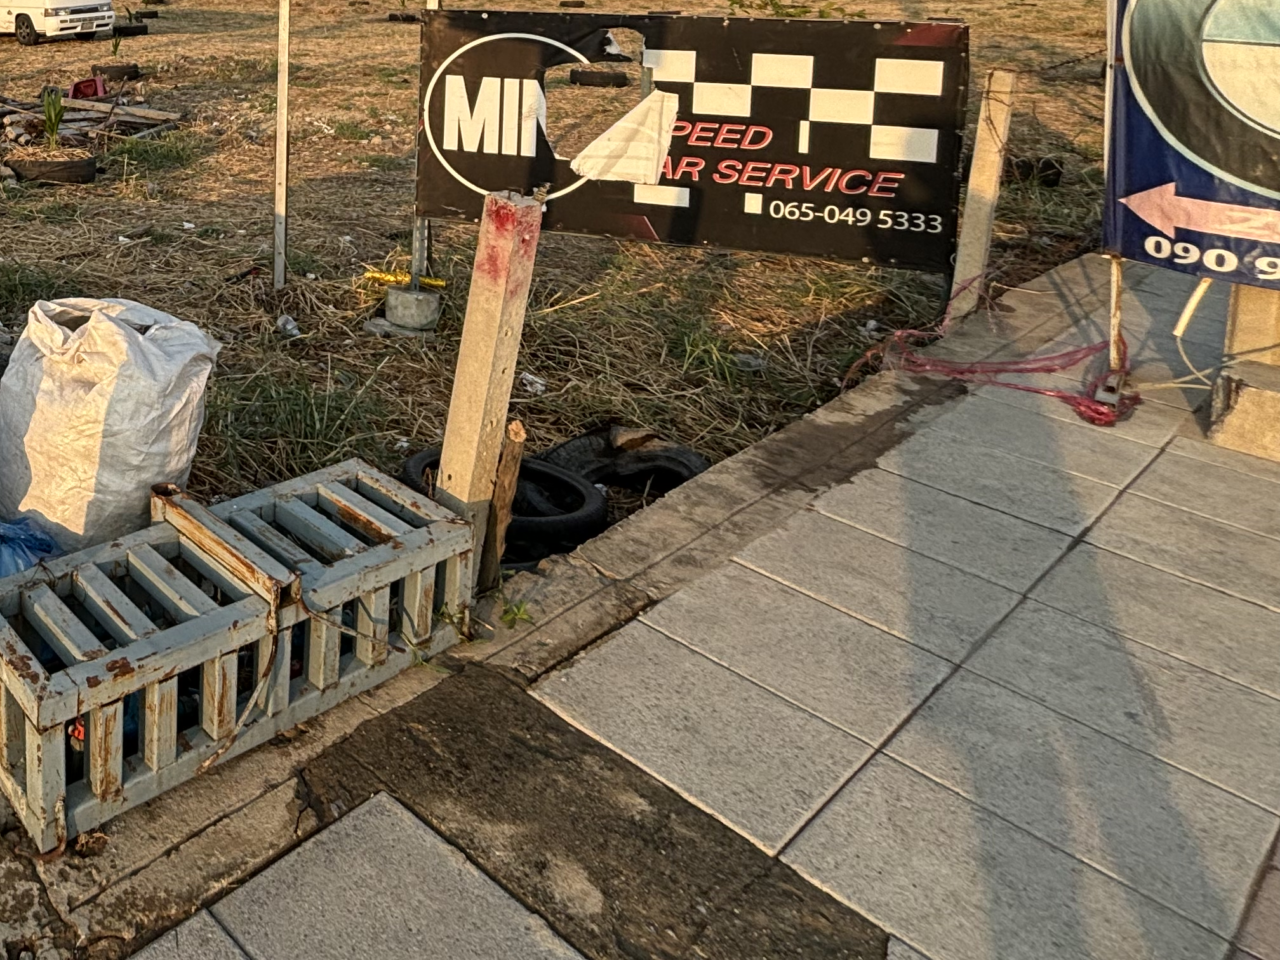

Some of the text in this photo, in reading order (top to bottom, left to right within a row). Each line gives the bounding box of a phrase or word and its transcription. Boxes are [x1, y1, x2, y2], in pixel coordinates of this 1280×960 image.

[443, 74, 547, 157] MIN
[670, 120, 773, 150] PEED
[661, 155, 905, 198] AR SERVICE
[769, 200, 943, 234] 065-049 5333
[1144, 235, 1238, 273] 090
